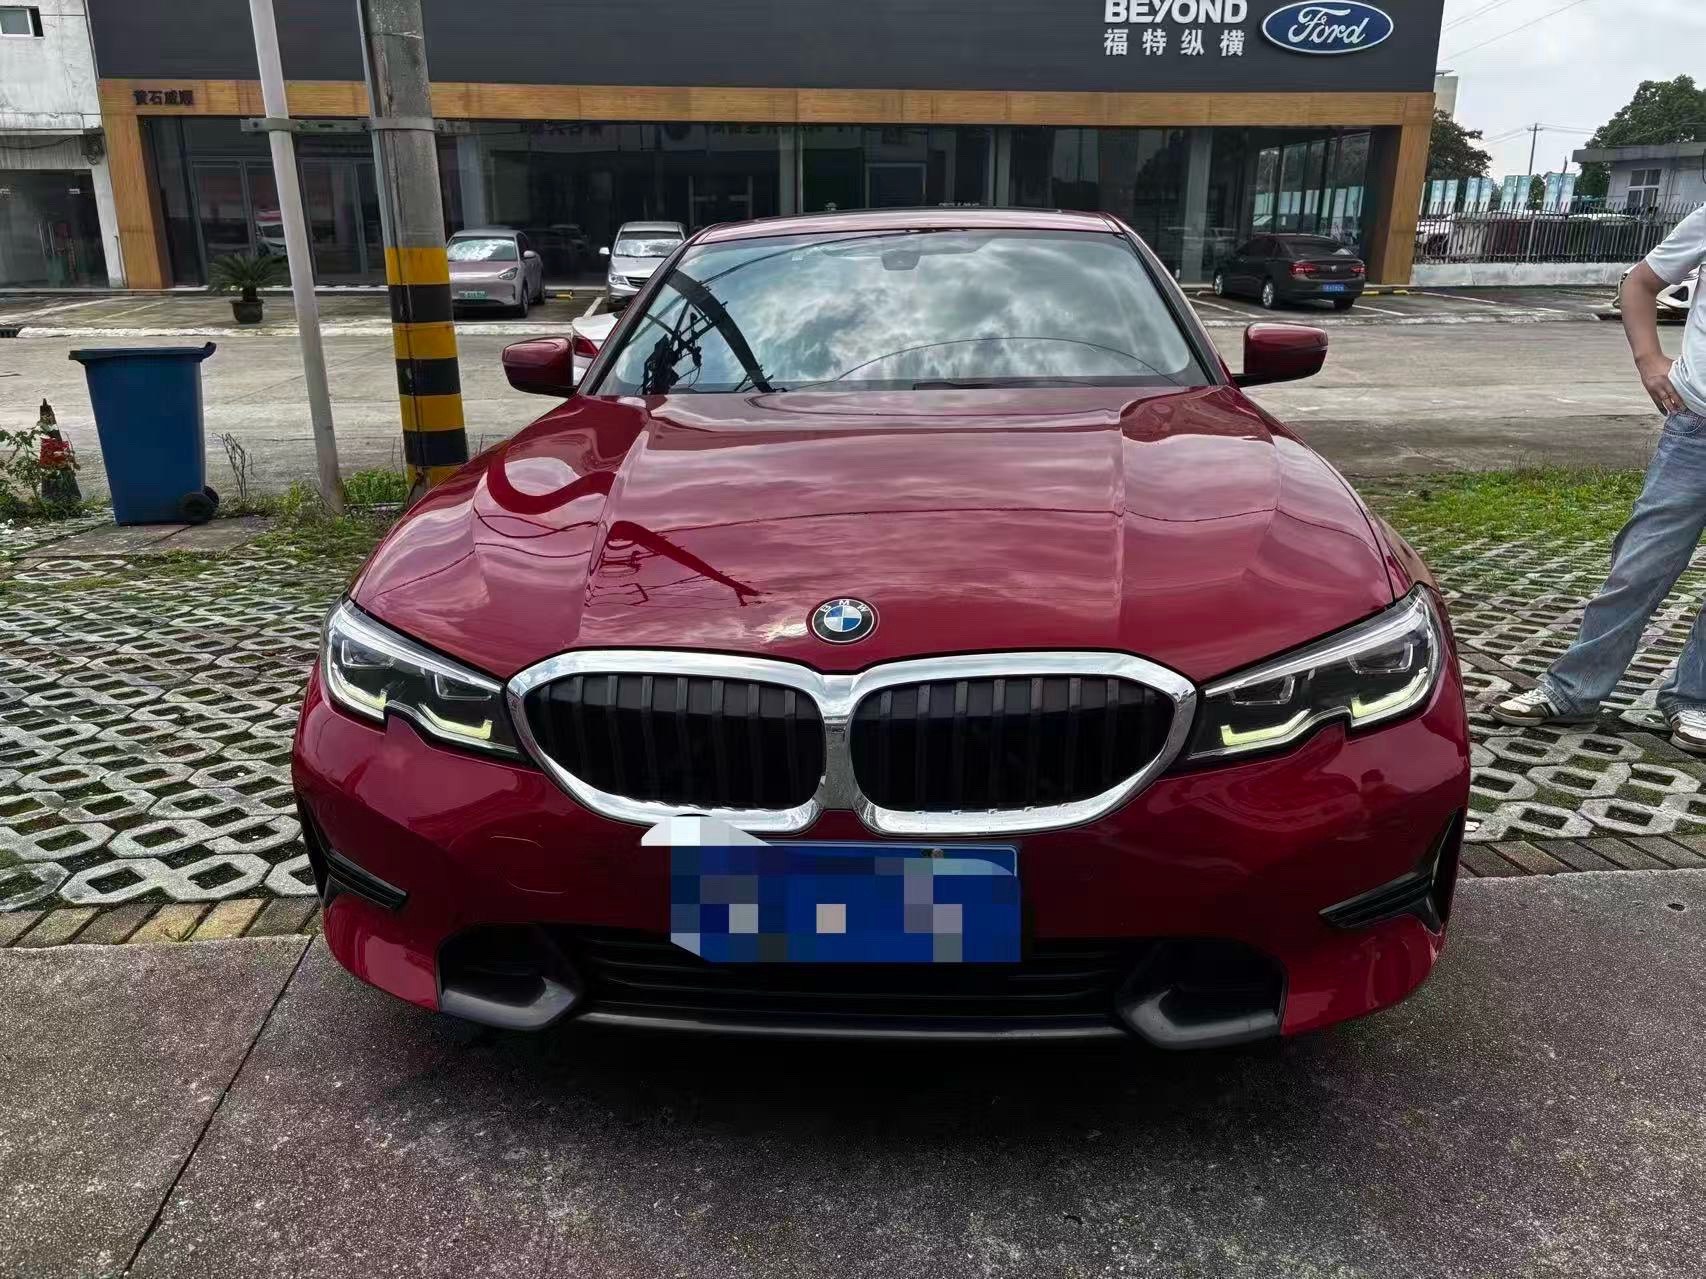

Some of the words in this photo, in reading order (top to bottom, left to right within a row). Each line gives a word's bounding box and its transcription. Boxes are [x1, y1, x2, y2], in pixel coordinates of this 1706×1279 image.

[1104, 0, 1248, 24] BEYOND
[1287, 6, 1369, 44] Ford
[1103, 28, 1245, 57] 福特纵横
[820, 599, 870, 613] BMW
